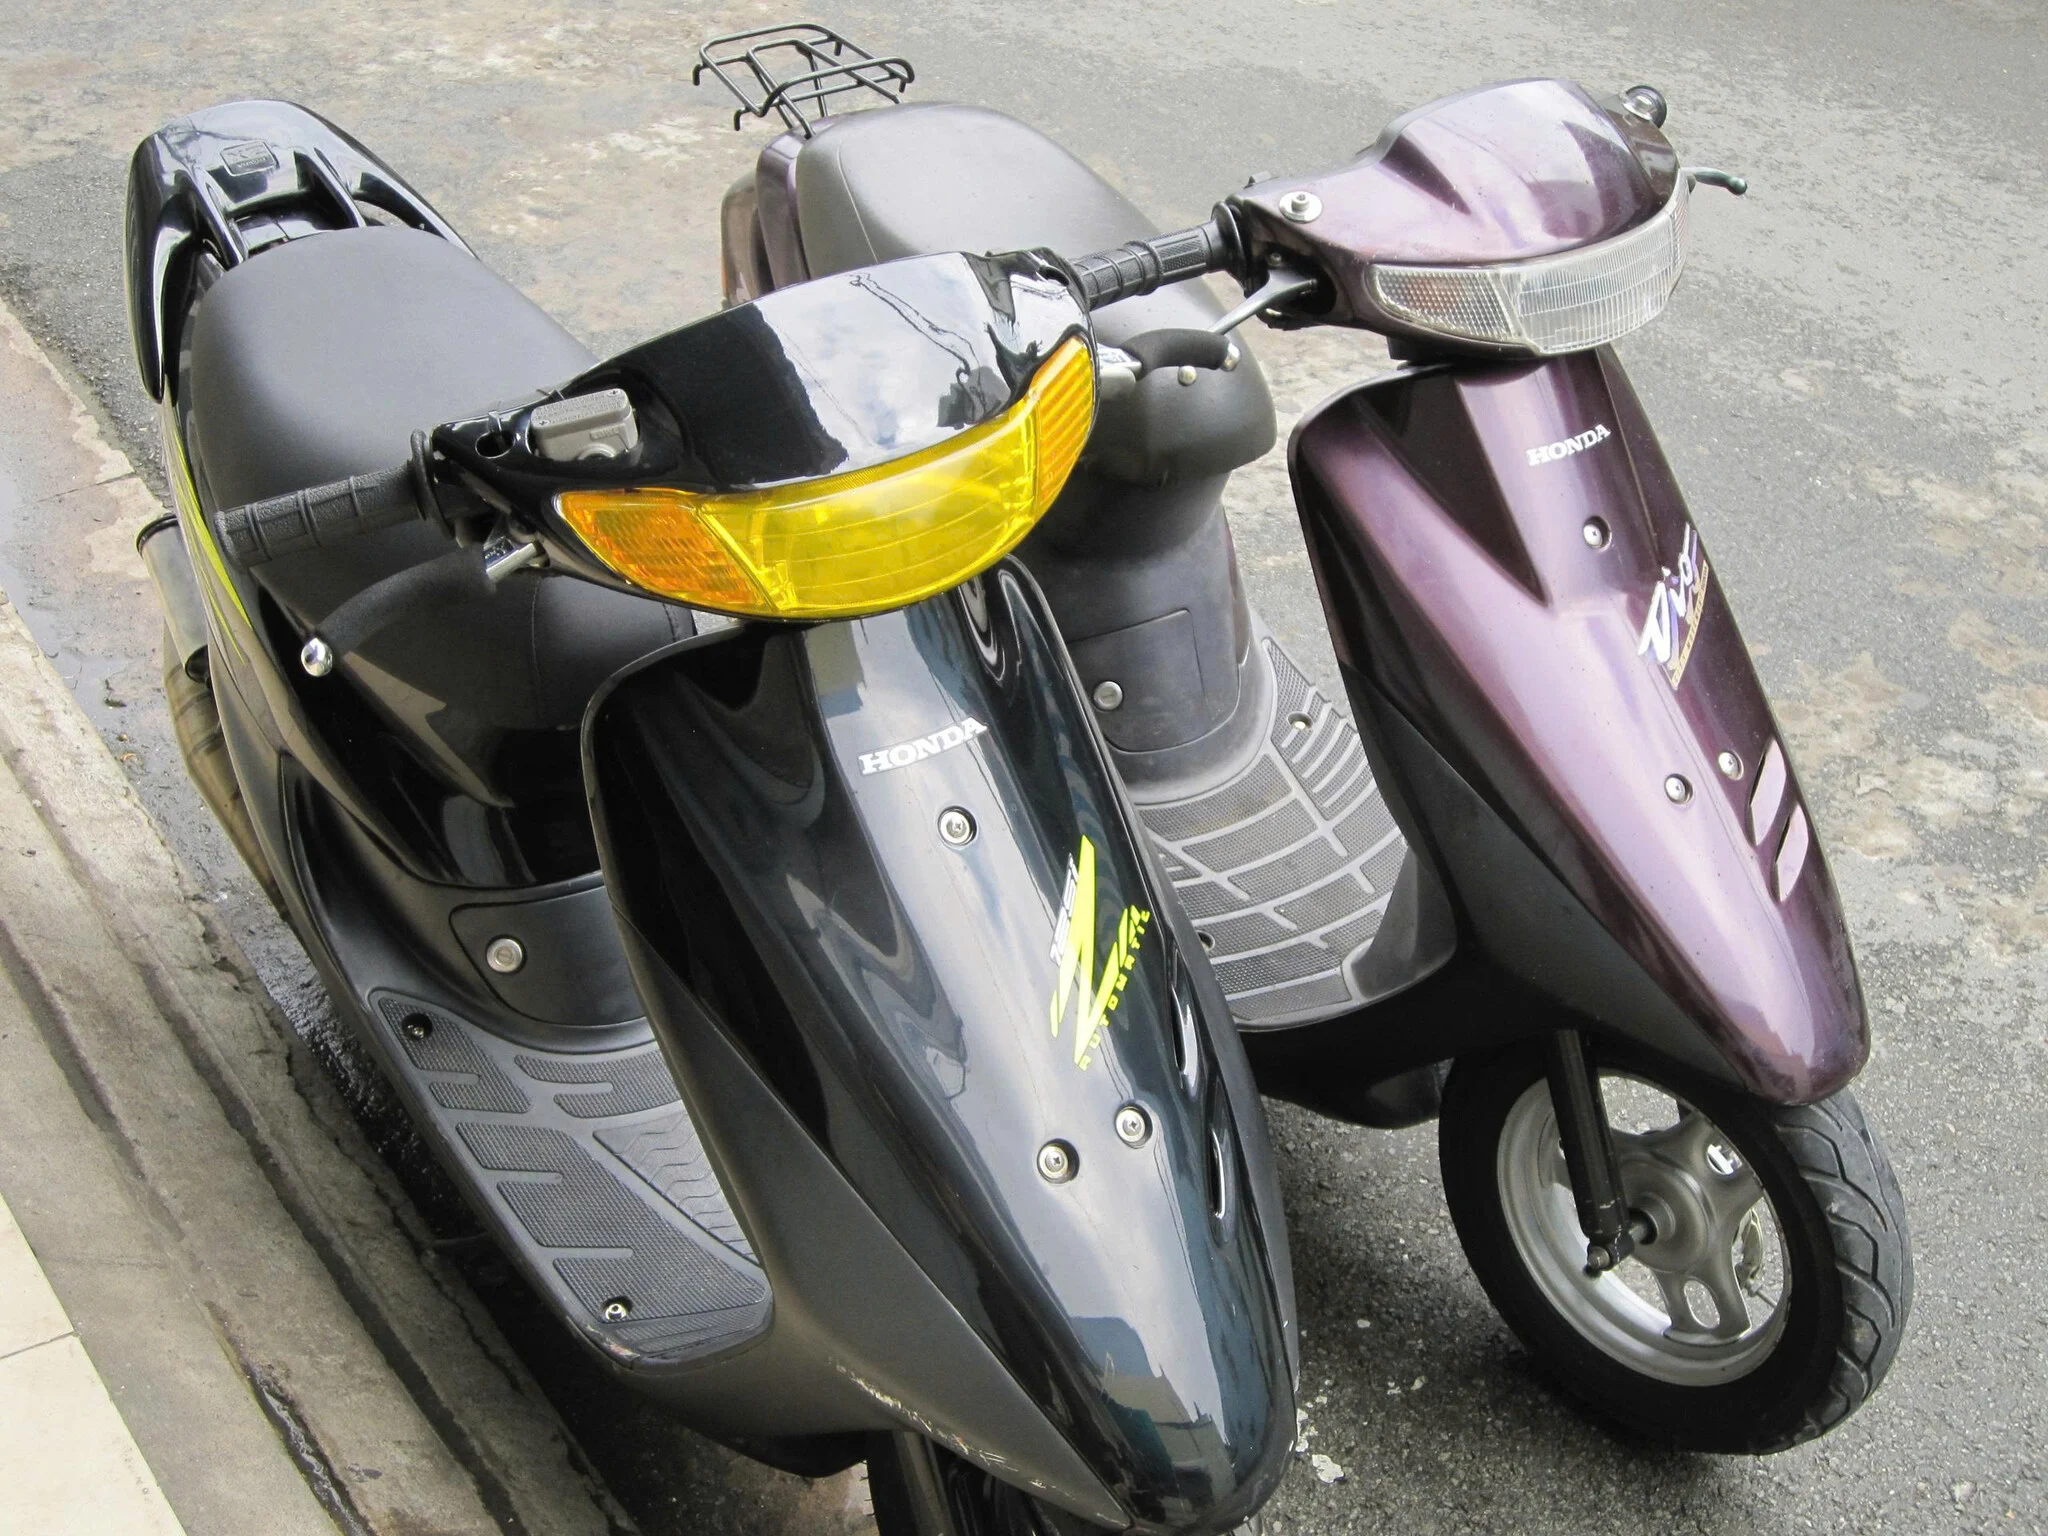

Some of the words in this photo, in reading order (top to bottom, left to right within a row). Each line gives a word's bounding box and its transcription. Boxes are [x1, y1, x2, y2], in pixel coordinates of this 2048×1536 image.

[1525, 423, 1611, 467] HONDA
[1638, 521, 1696, 668] Dio
[858, 716, 988, 776] HONDA
[1078, 906, 1151, 1073] AUTOMATIC
